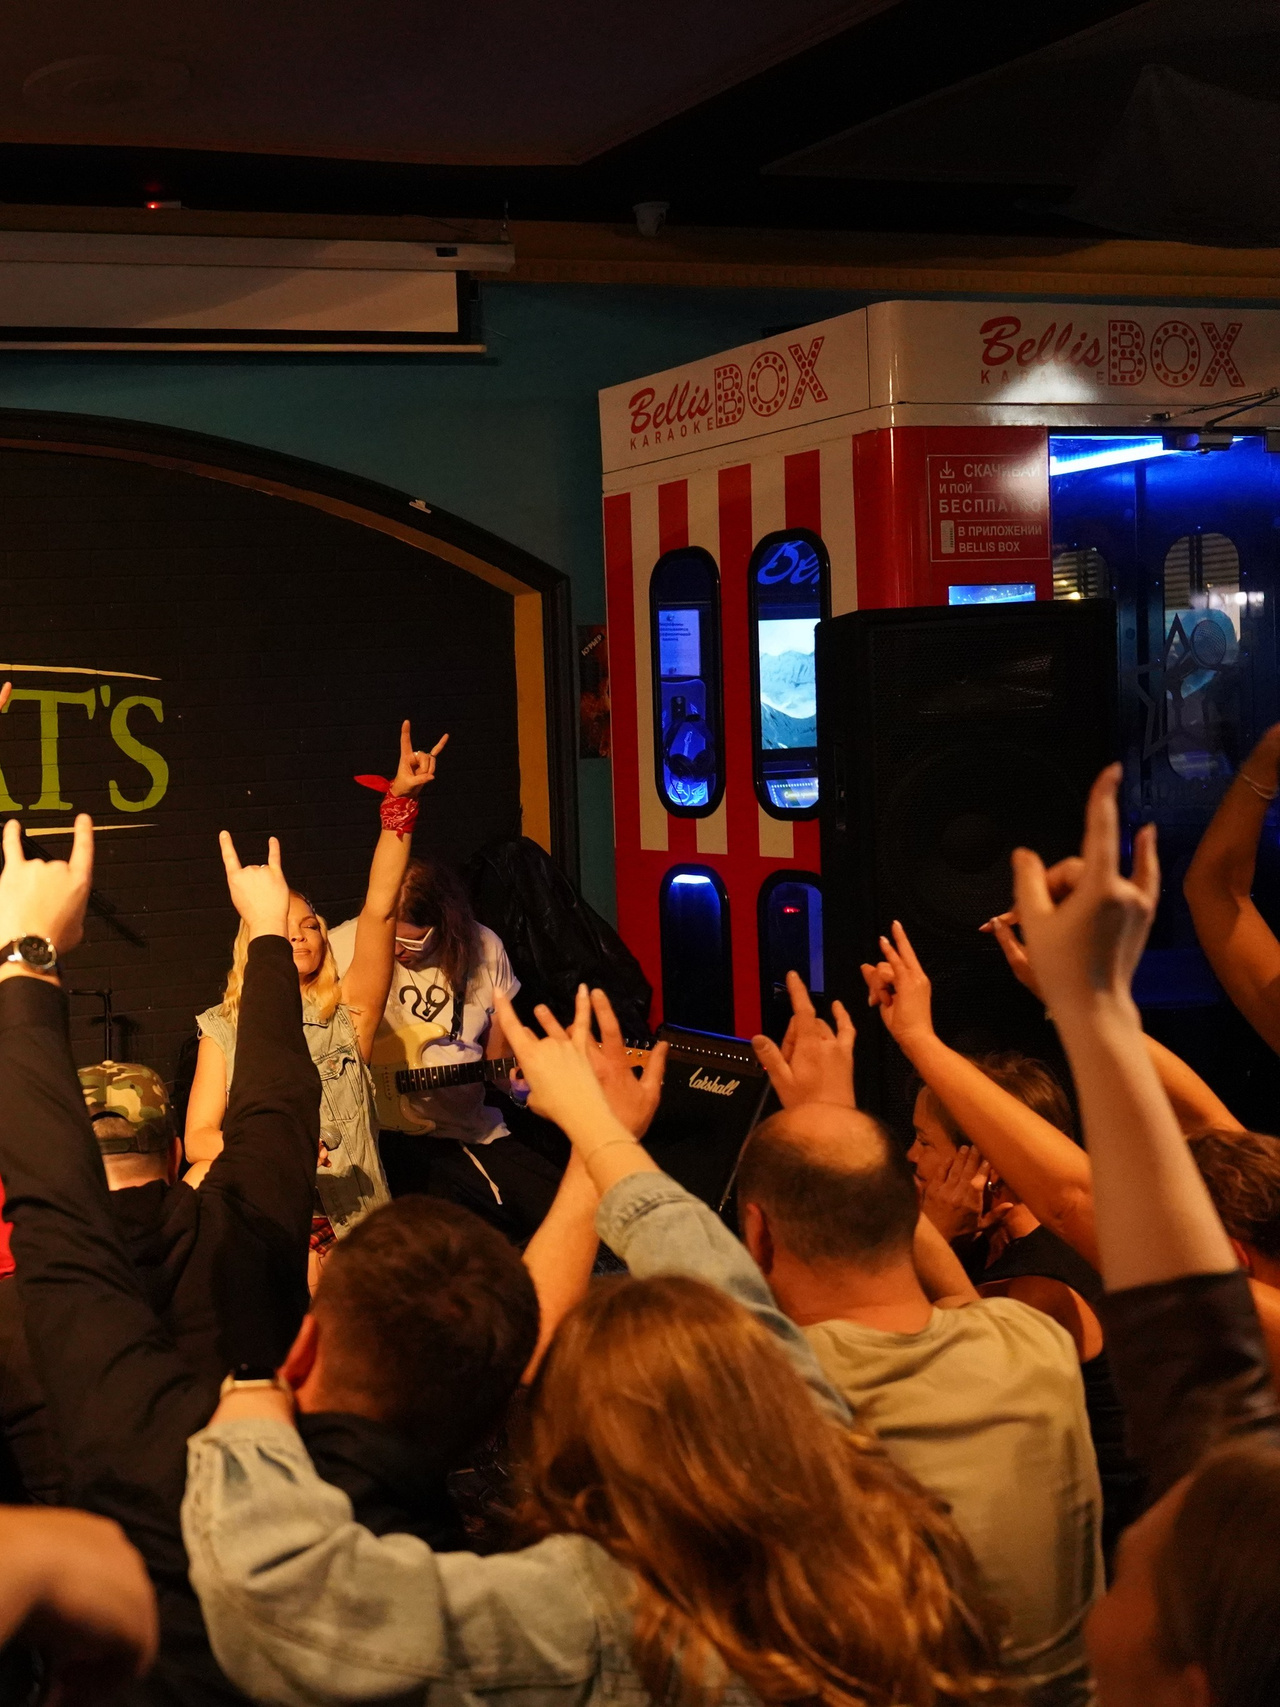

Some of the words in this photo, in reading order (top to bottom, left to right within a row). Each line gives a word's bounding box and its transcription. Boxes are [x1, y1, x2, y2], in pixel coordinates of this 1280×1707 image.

[979, 315, 1105, 368] Bellis
[1107, 319, 1246, 388] BOX
[628, 380, 714, 434] Bellis
[714, 336, 829, 429] BOX
[630, 416, 714, 451] KARAOKE
[939, 483, 947, 494] И
[949, 481, 973, 494] ПОЙ
[958, 526, 966, 537] В
[968, 525, 1043, 537] ПРИЛОЖЕНИИ
[959, 541, 996, 553] BELLIS
[998, 541, 1021, 553] BOX
